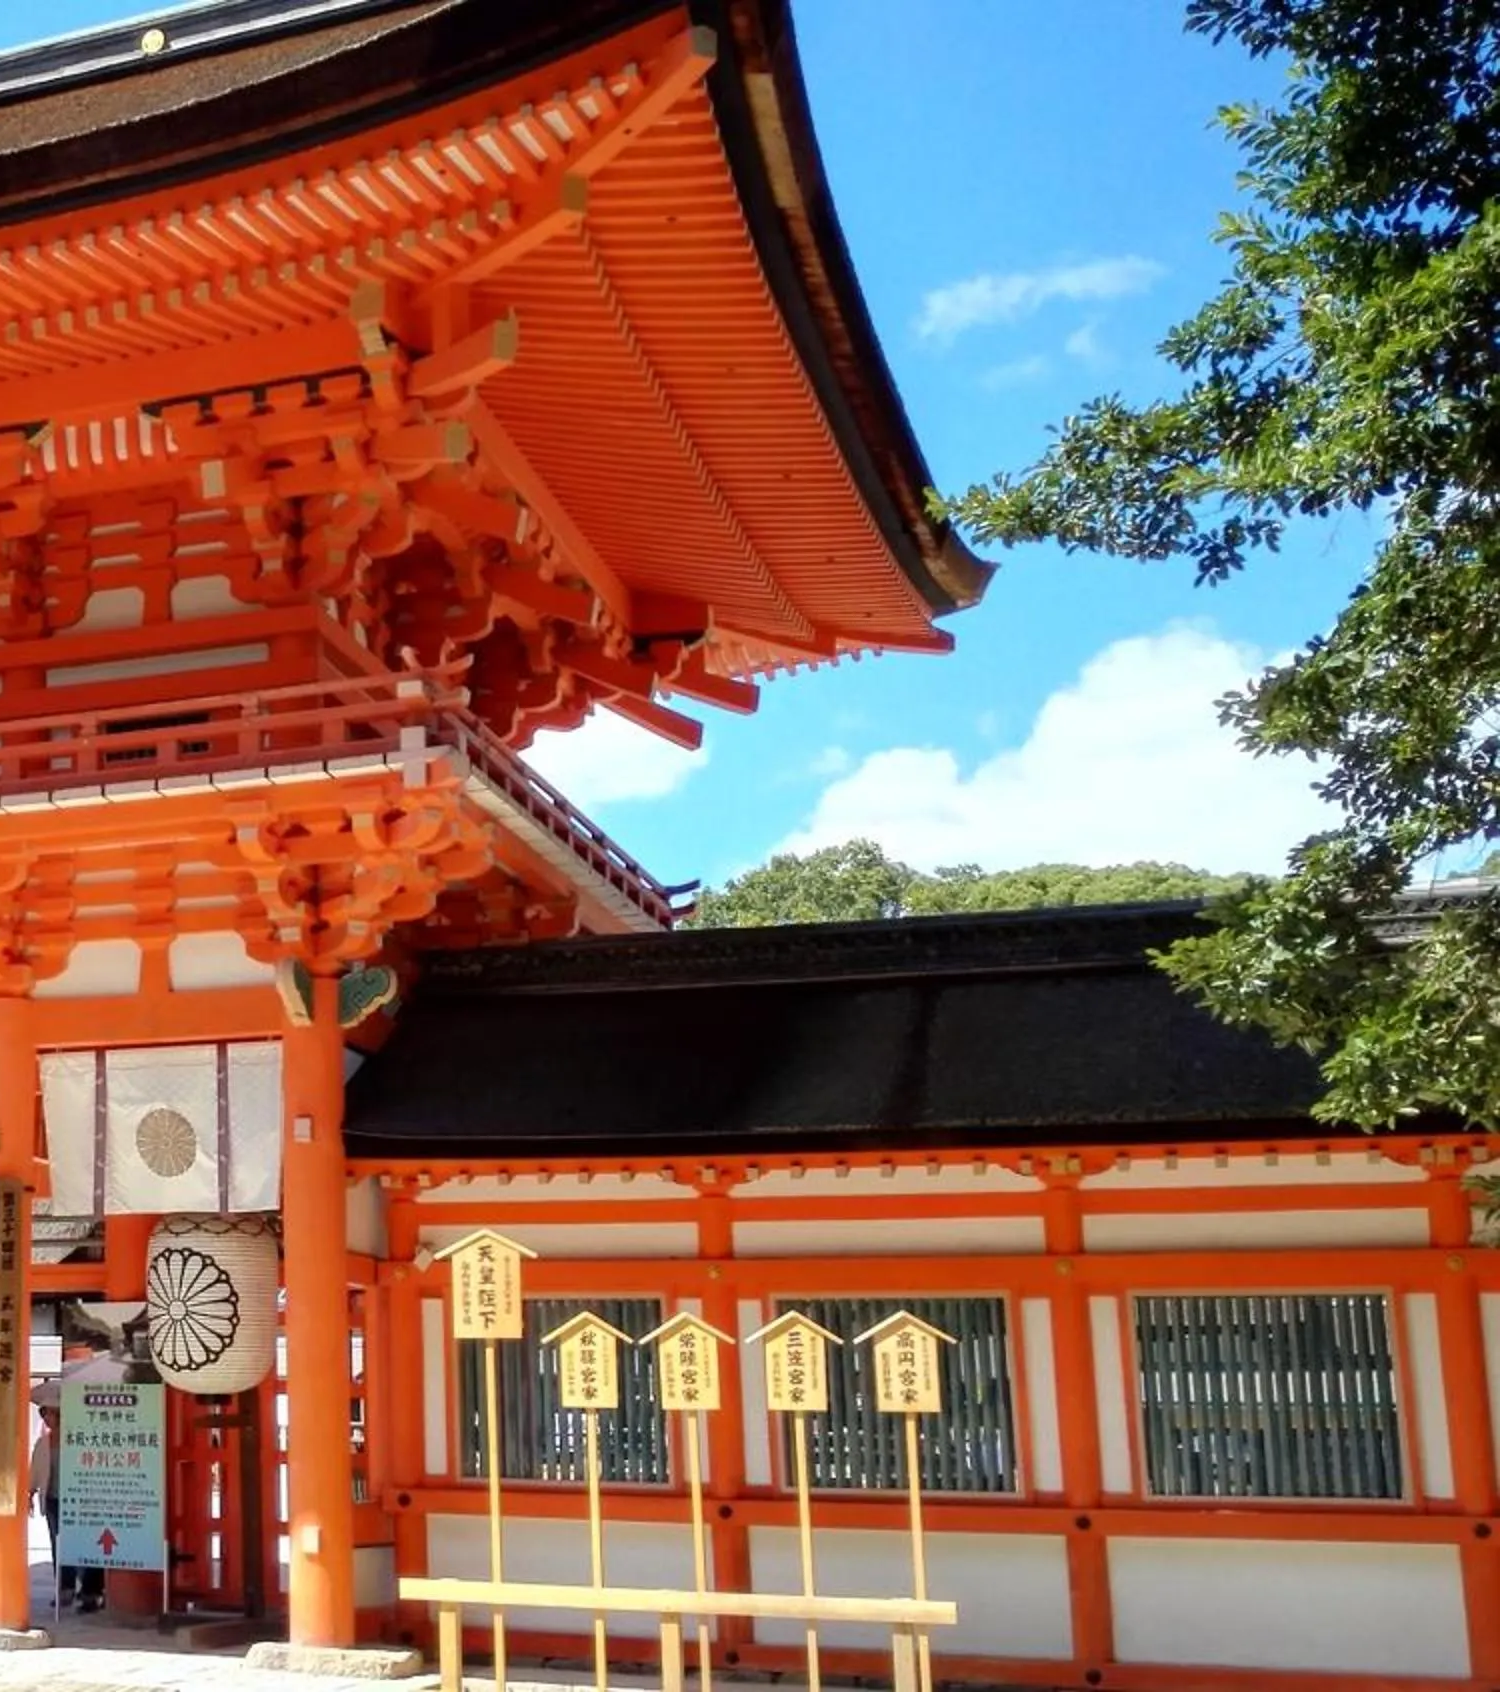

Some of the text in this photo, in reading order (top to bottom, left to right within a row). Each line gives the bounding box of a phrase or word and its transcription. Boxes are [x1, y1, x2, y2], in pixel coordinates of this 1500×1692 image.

[478, 1244, 497, 1330] 天皇陛下
[786, 1331, 805, 1404] 三笠宮家
[896, 1331, 918, 1404] 高円宮家
[81, 1450, 141, 1470] 特別公開
